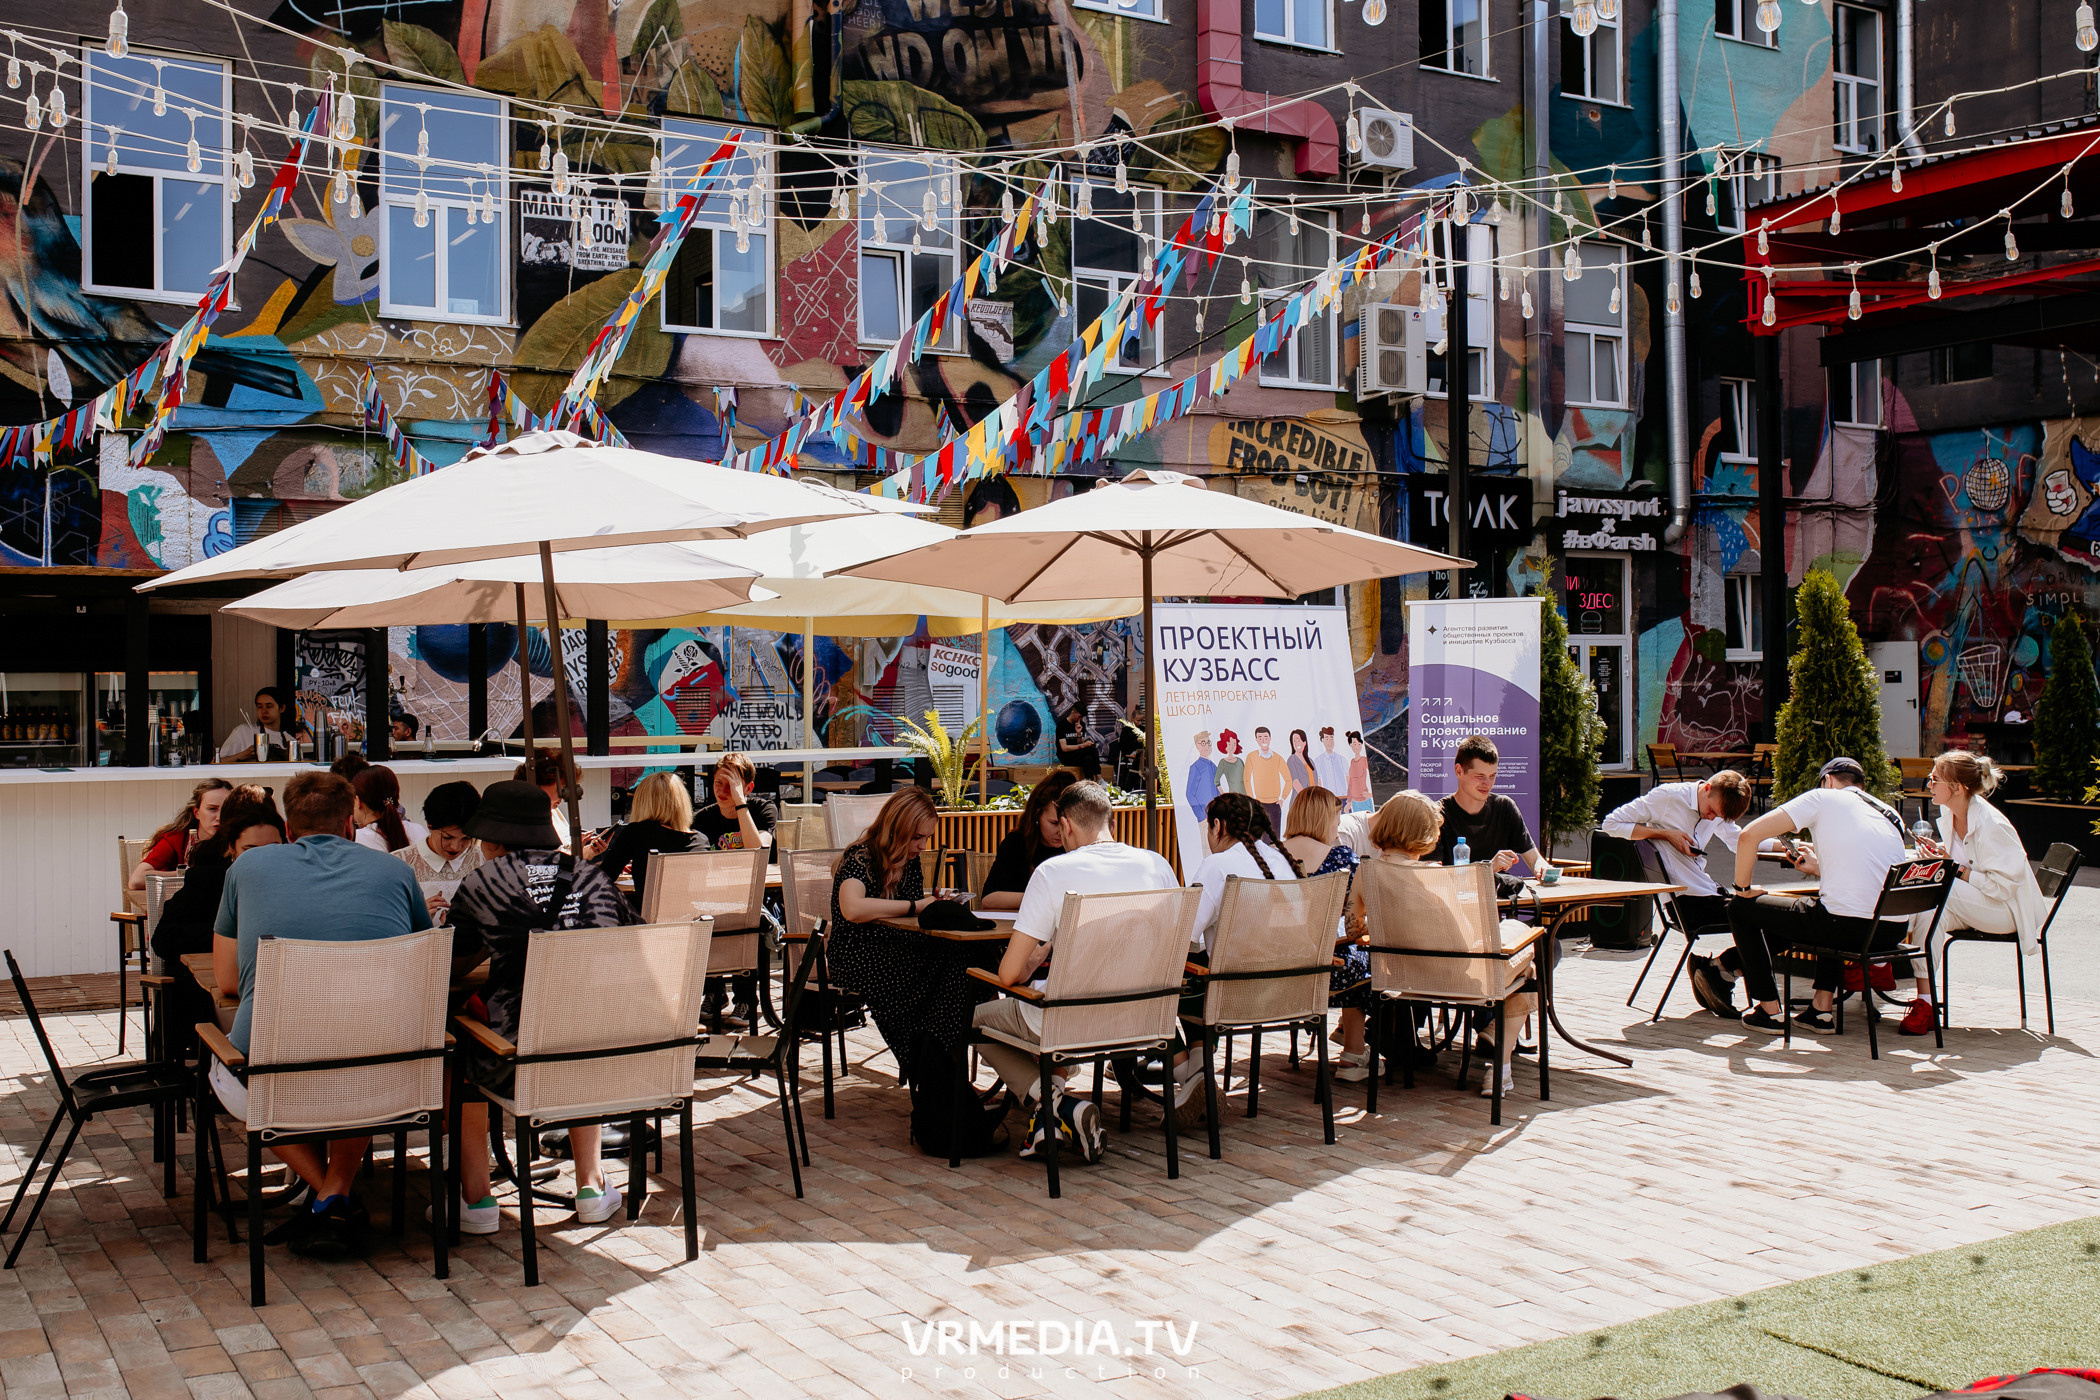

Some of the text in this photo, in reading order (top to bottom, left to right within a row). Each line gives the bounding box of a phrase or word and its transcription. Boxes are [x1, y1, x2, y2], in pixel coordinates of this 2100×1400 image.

[523, 193, 563, 217] MAN
[597, 200, 628, 223] TH
[577, 222, 627, 246] OON
[576, 250, 591, 258] FROM
[602, 247, 626, 255] MESSAGE
[577, 259, 606, 267] BREATHING
[1227, 420, 1364, 482] INCREDIBLE
[1555, 490, 1662, 522] jawsspot
[1159, 619, 1323, 650] ПРОЕКТНЫЙ
[1163, 657, 1280, 683] КУЗБАСС
[1165, 689, 1277, 703] ЛЕТНЯЯ ПРОЕКТНАЯ
[716, 700, 753, 719] WHAT
[1166, 704, 1213, 717] ШКОЛА
[1421, 713, 1499, 725] Социальное
[761, 723, 782, 739] DO
[1421, 726, 1528, 738] проектирование
[1421, 737, 1466, 750] в Кузб
